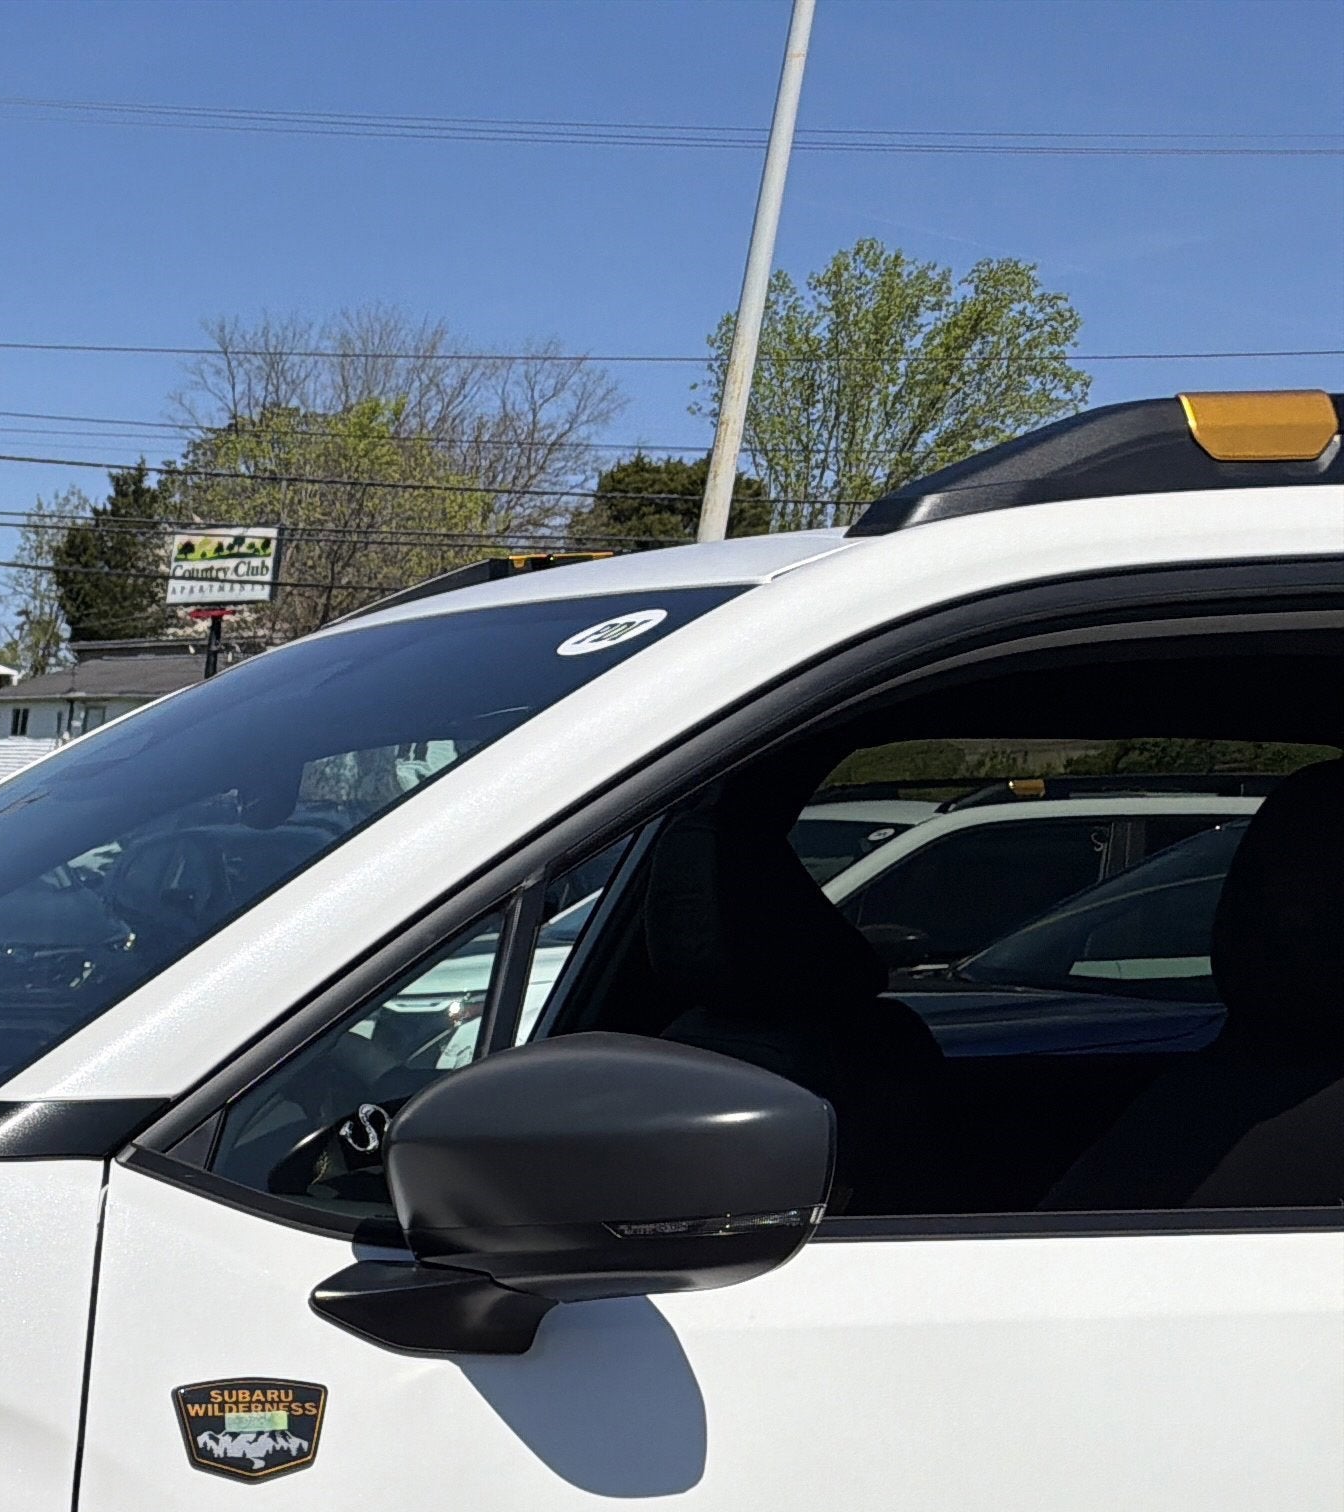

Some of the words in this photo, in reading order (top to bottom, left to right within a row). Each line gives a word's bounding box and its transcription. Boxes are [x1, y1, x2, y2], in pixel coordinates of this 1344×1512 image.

[171, 563, 230, 580] Country
[233, 559, 270, 578] Club
[209, 1389, 294, 1402] SUBARU
[186, 1402, 318, 1417] WILDERNESS
